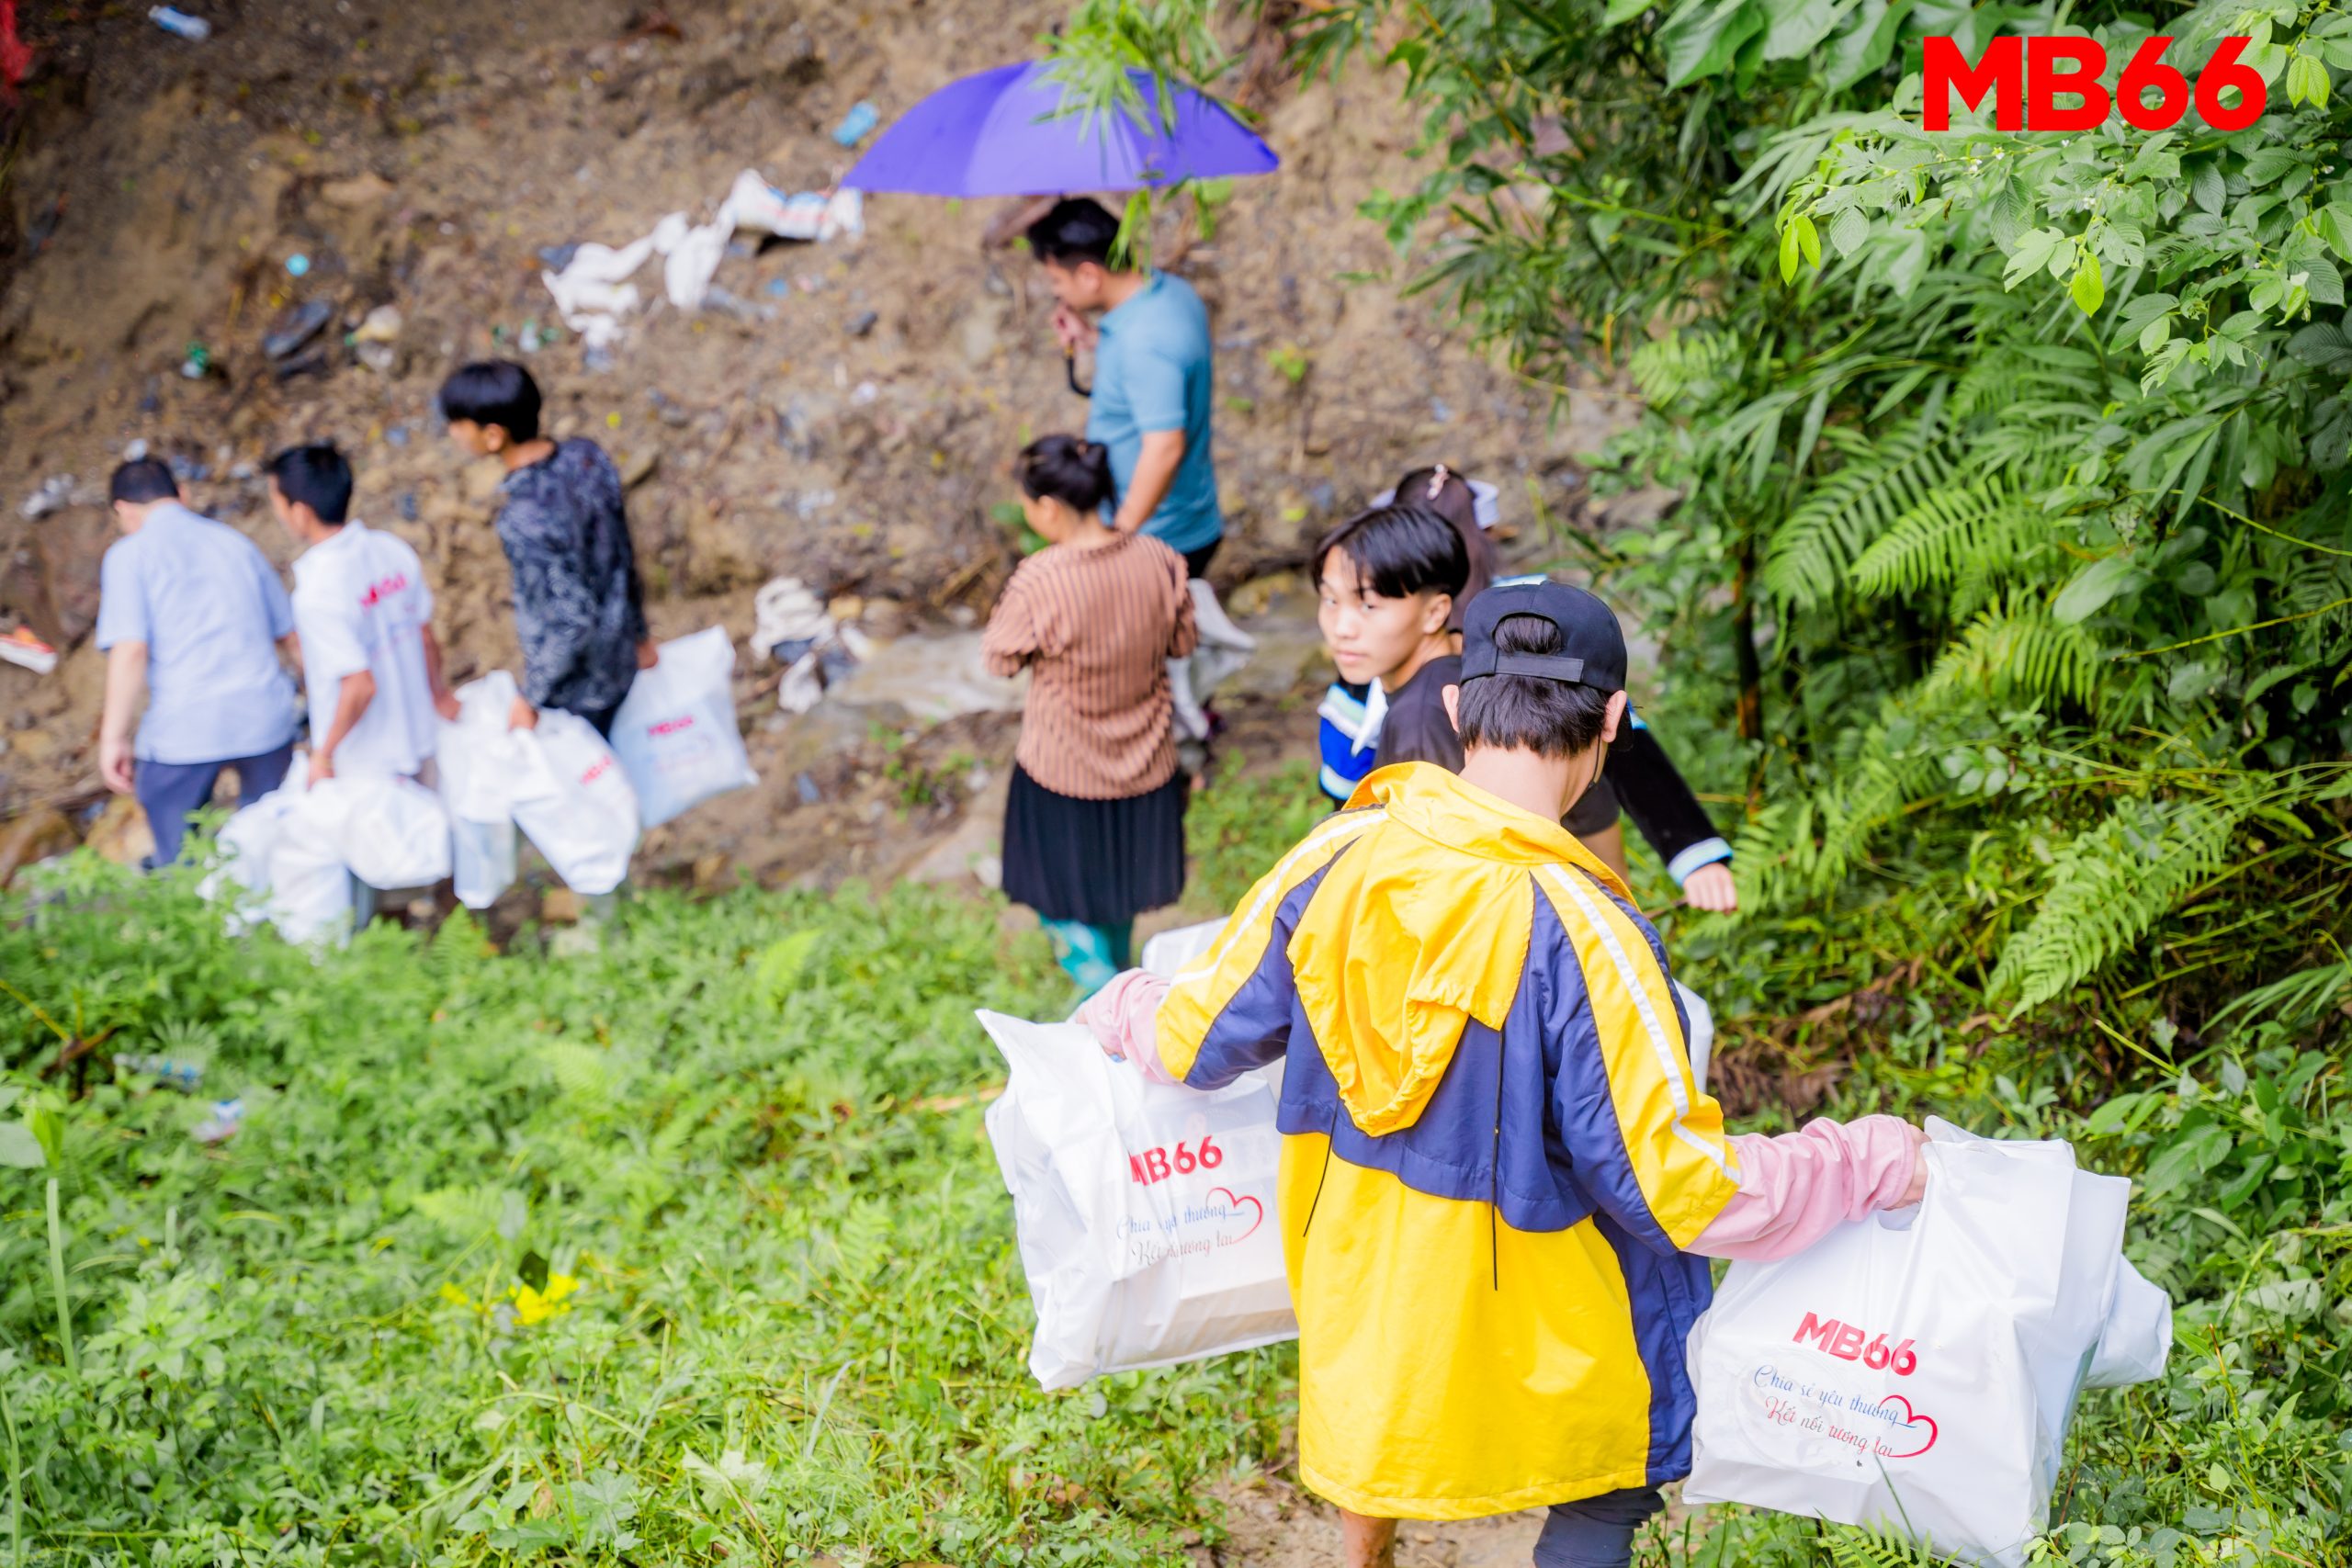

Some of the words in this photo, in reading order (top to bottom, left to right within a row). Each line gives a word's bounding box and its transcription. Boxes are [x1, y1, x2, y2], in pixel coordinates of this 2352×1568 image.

[1792, 1312, 1917, 1377] MB66
[1754, 1364, 1794, 1392] Chia
[1800, 1416, 1824, 1433] nối
